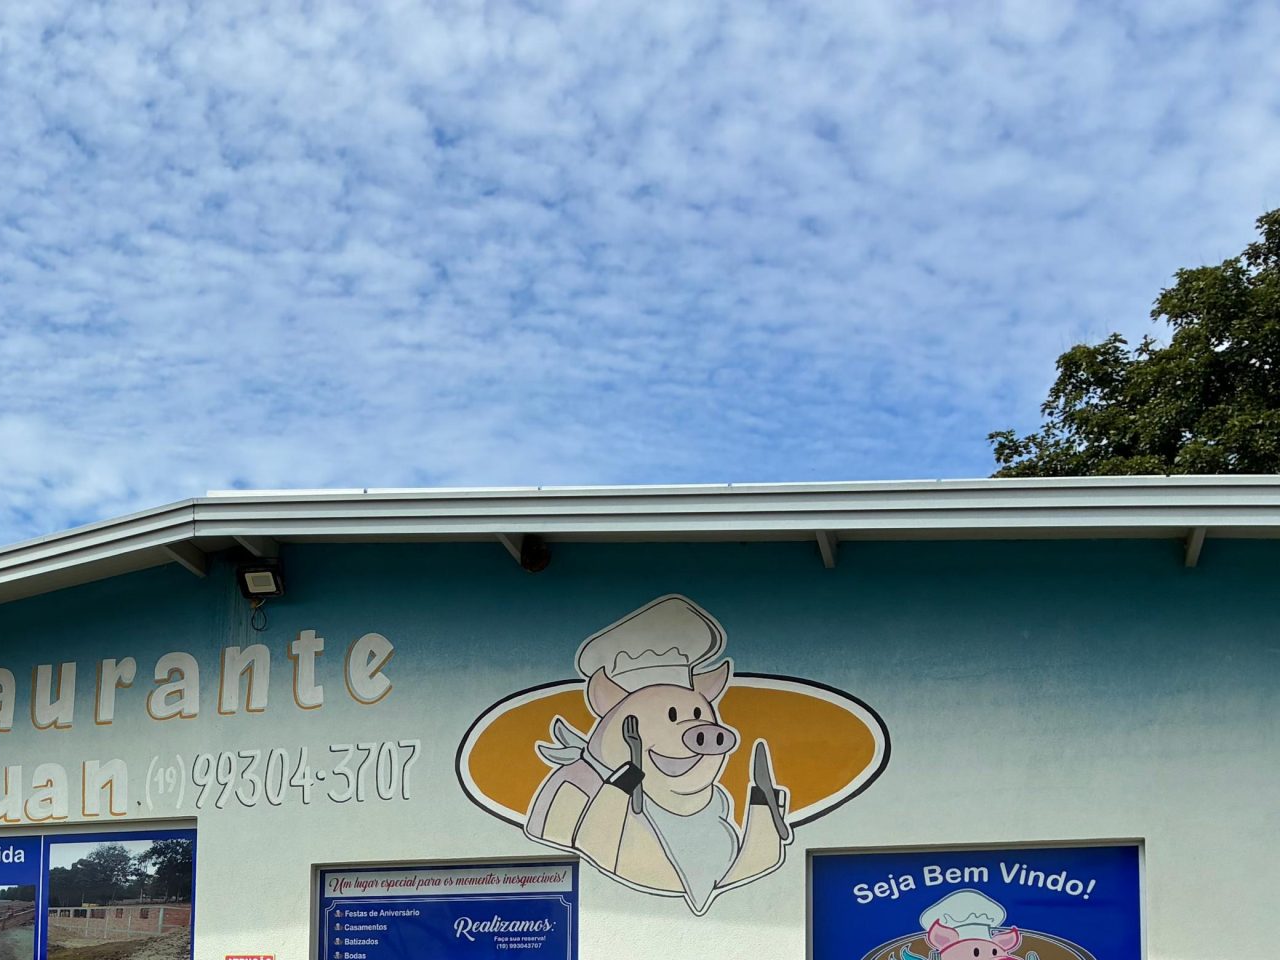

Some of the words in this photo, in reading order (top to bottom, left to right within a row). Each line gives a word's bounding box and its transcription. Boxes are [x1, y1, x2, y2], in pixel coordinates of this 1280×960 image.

[329, 877, 352, 895] Um
[353, 876, 379, 893] lugar
[380, 875, 417, 892] especial
[416, 876, 441, 890] para
[443, 876, 454, 886] os
[455, 872, 501, 886] momentos
[853, 874, 916, 904] Seja
[923, 865, 989, 886] Bem
[999, 862, 1096, 900] Vindo!
[344, 909, 368, 918] Festas
[368, 909, 379, 917] de
[379, 907, 420, 917] Aniversário
[344, 922, 388, 931] Casamentos
[453, 914, 557, 942] Realizamos:
[344, 938, 379, 946] Batizados
[344, 952, 367, 960] Bodas
